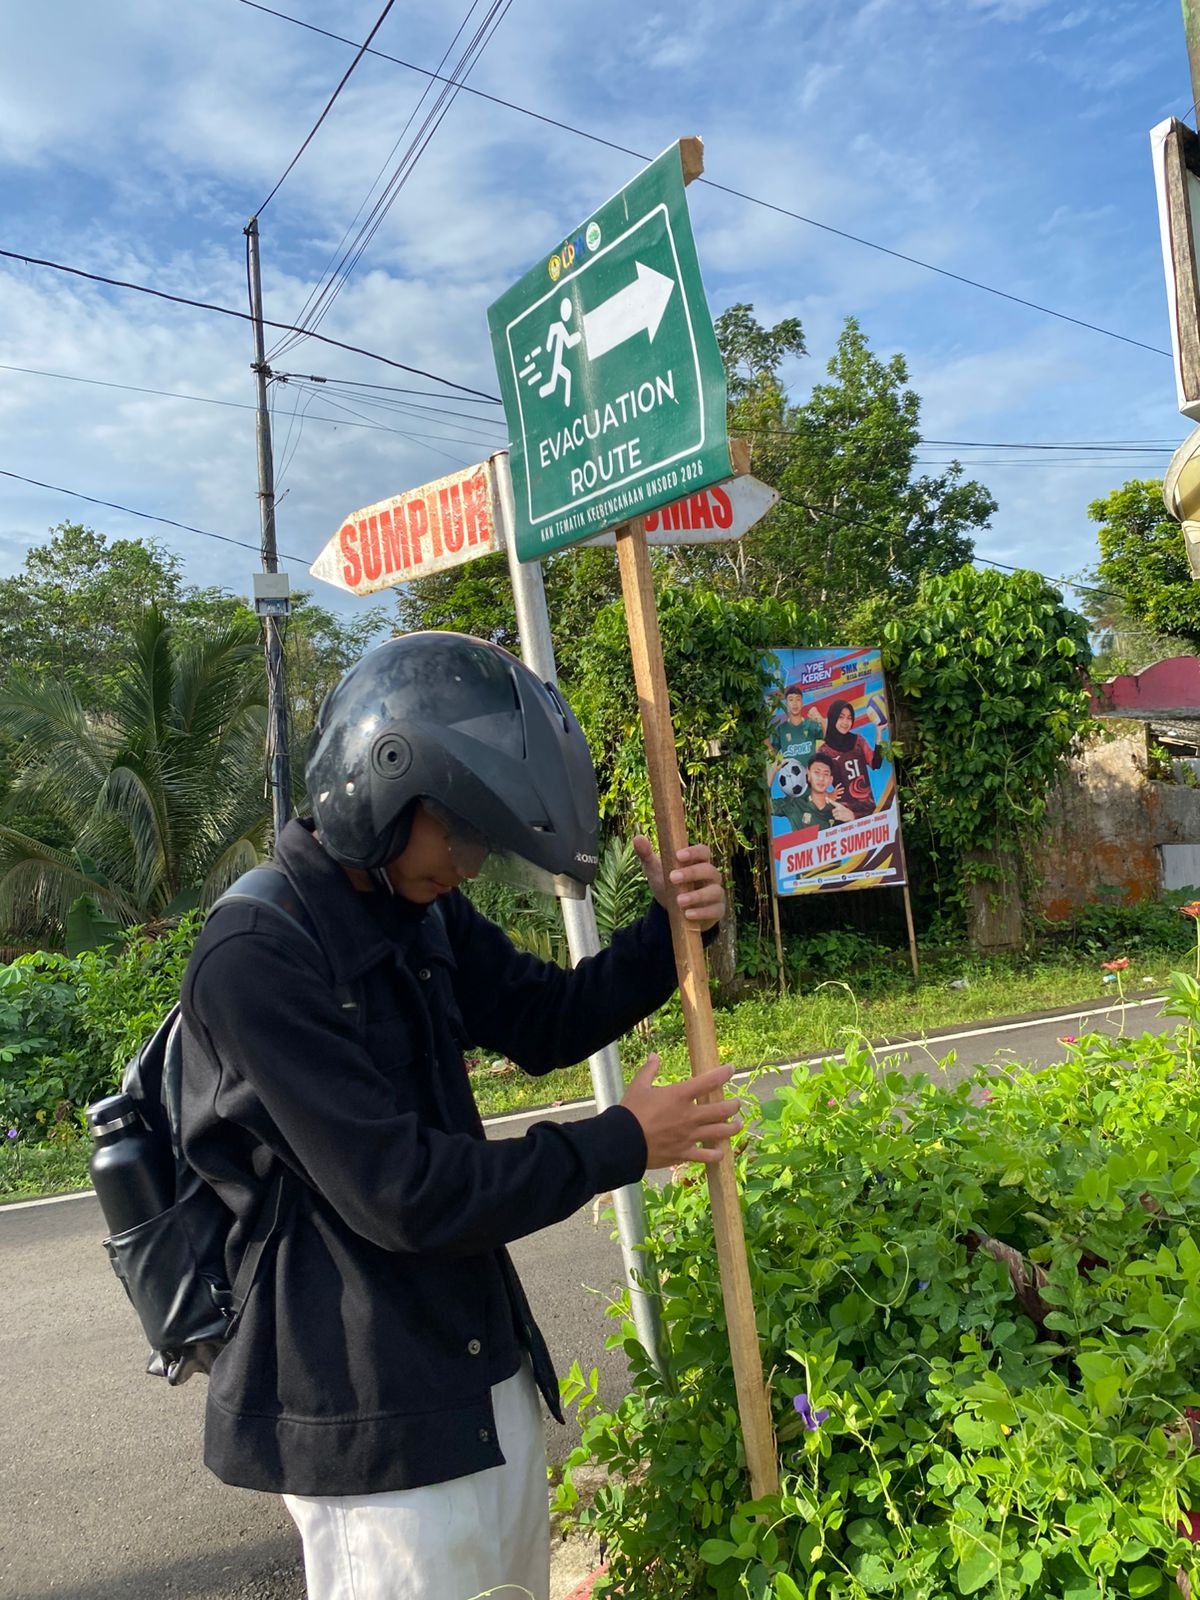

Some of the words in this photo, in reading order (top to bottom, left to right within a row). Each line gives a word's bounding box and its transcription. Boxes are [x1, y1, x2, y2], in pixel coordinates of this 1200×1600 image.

[539, 370, 675, 468] EVACUATION
[571, 438, 642, 496] ROUTE
[555, 510, 586, 535] TEMATIK
[646, 471, 678, 497] UNSOED
[680, 459, 704, 483] 2026
[801, 667, 832, 685] KEREN
[806, 661, 825, 673] YPE
[841, 662, 858, 676] SMK
[787, 848, 814, 873] SMK
[816, 841, 837, 863] YPE
[840, 823, 890, 856] SUMPIUH
